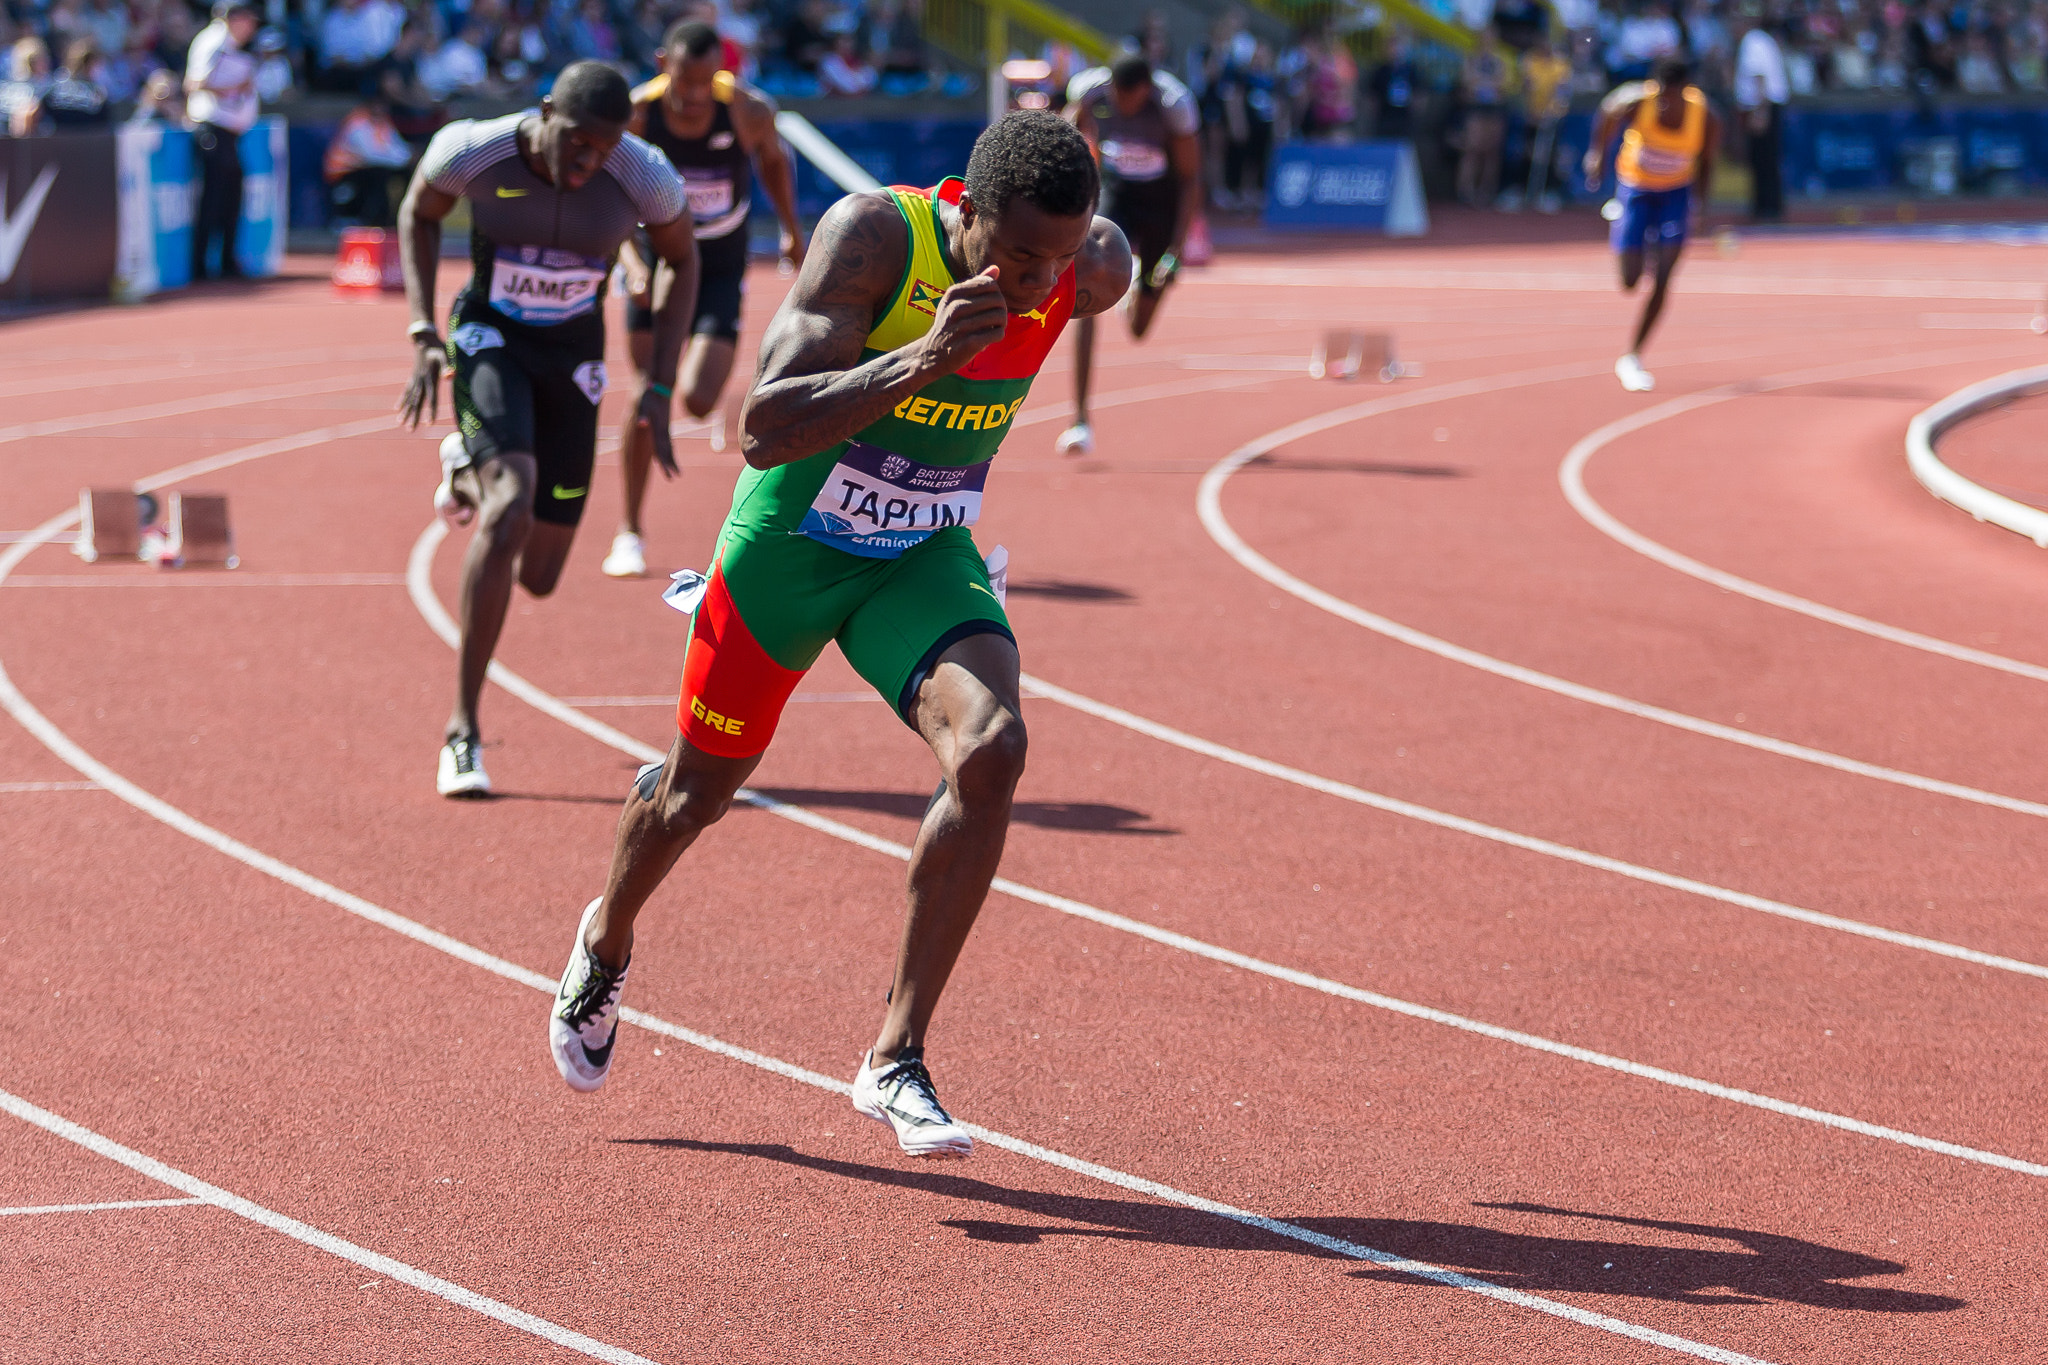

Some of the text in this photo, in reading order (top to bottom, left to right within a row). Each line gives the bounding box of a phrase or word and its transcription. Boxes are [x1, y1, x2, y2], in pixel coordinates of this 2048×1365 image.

[466, 328, 484, 348] 5
[589, 365, 603, 395] 5
[908, 478, 962, 489] ATHLETICS
[915, 468, 968, 480] BRITISH
[690, 695, 746, 736] GRE
